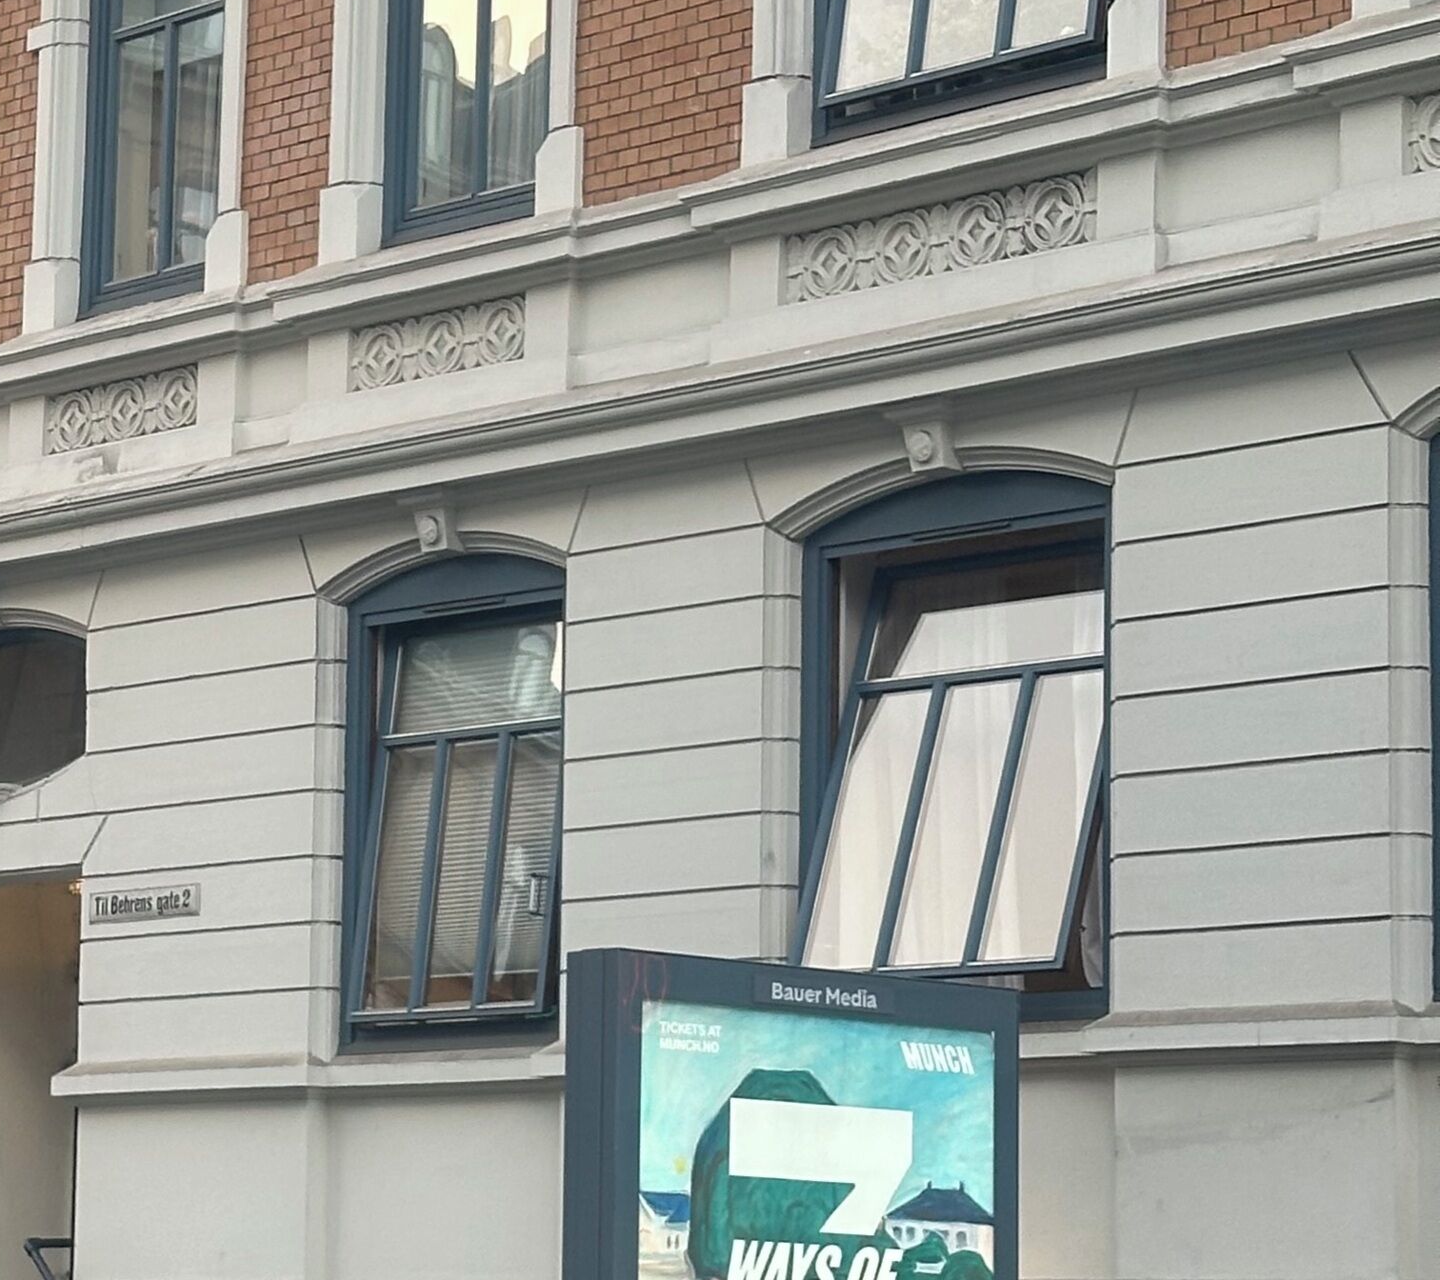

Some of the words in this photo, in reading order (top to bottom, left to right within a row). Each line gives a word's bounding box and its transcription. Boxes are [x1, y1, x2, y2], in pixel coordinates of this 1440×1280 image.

[94, 896, 109, 916] Til
[110, 895, 153, 915] Behrens
[156, 890, 180, 915] gate
[182, 888, 191, 908] 2
[771, 982, 823, 1005] Bauer
[825, 988, 878, 1010] Media
[659, 1020, 706, 1037] TICKETS
[707, 1024, 723, 1038] AT
[899, 1040, 976, 1076] MUNCH
